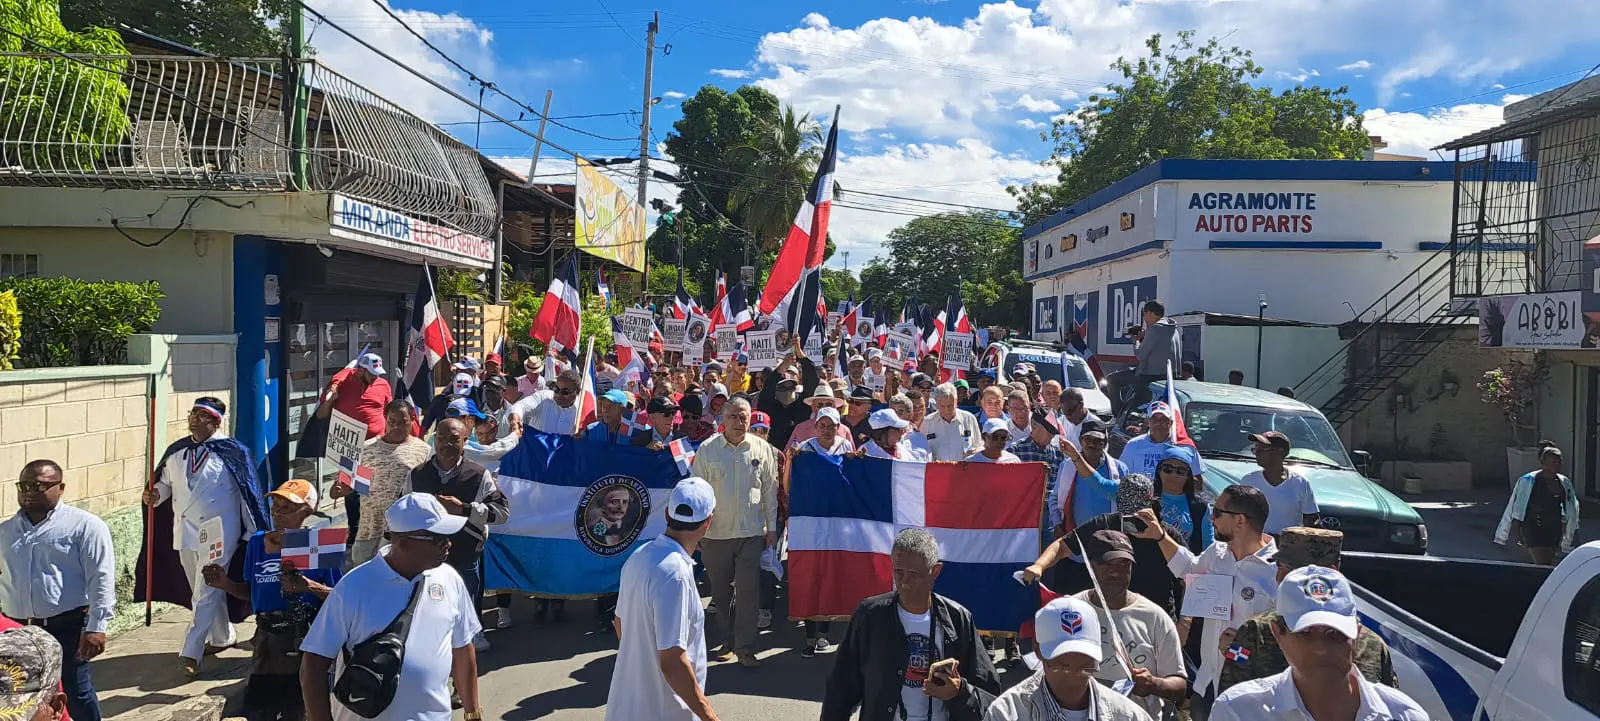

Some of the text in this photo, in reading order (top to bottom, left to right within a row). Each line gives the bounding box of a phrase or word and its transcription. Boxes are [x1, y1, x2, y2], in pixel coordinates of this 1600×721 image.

[1188, 193, 1317, 210] AGRAMONTE
[341, 199, 411, 240] MIRANDA
[413, 220, 455, 250] ELECTRO
[455, 233, 490, 259] SERVICE
[1195, 215, 1313, 233] AUTO PARTS
[625, 315, 651, 328] CENTRO
[632, 332, 649, 343] AZUA
[964, 340, 972, 348] LA
[756, 352, 764, 360] LA
[333, 422, 361, 446] HAITÍ
[327, 438, 337, 450] DE
[336, 444, 345, 456] LA
[580, 477, 615, 508] INSTITUTO
[605, 527, 641, 554] DOMINICANA
